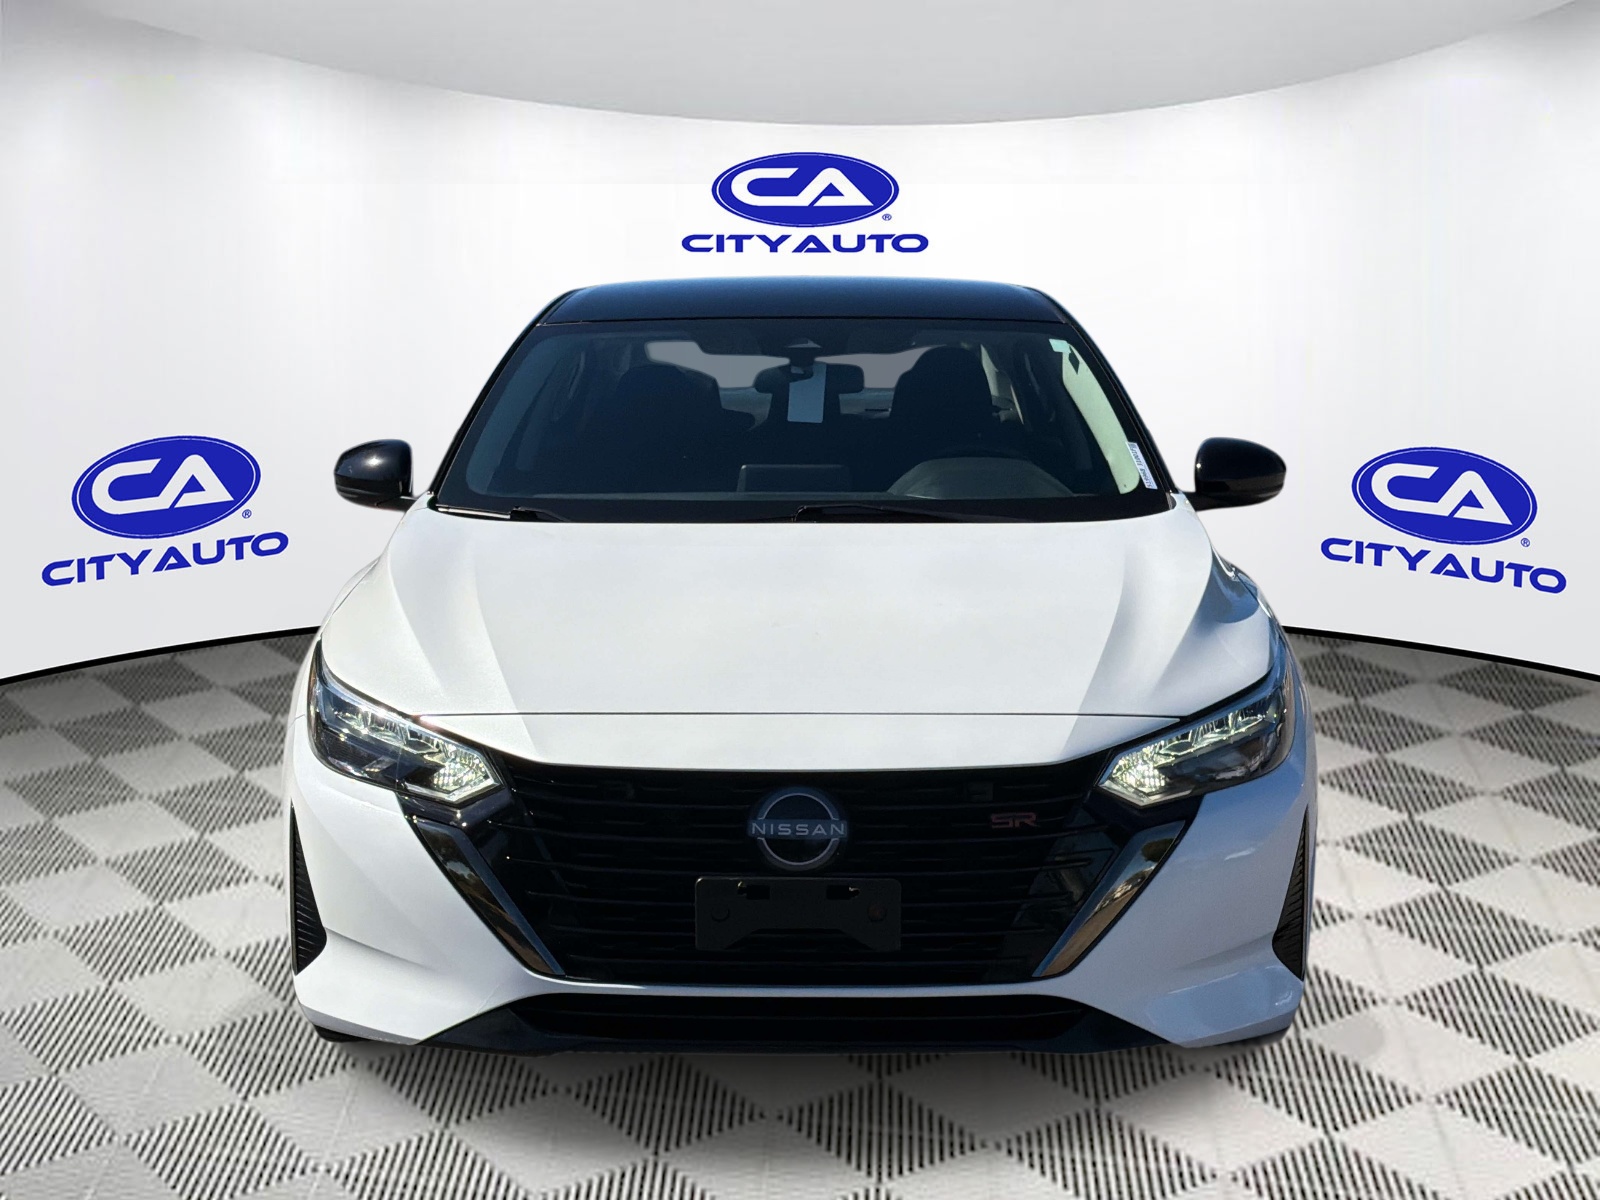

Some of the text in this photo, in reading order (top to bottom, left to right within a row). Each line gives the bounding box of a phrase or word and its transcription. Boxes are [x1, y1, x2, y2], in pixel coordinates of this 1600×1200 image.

[731, 167, 875, 207] CA
[91, 454, 235, 515] CA
[1371, 462, 1513, 526] CA
[751, 823, 845, 836] NISSAN
[990, 812, 1038, 829] SR
